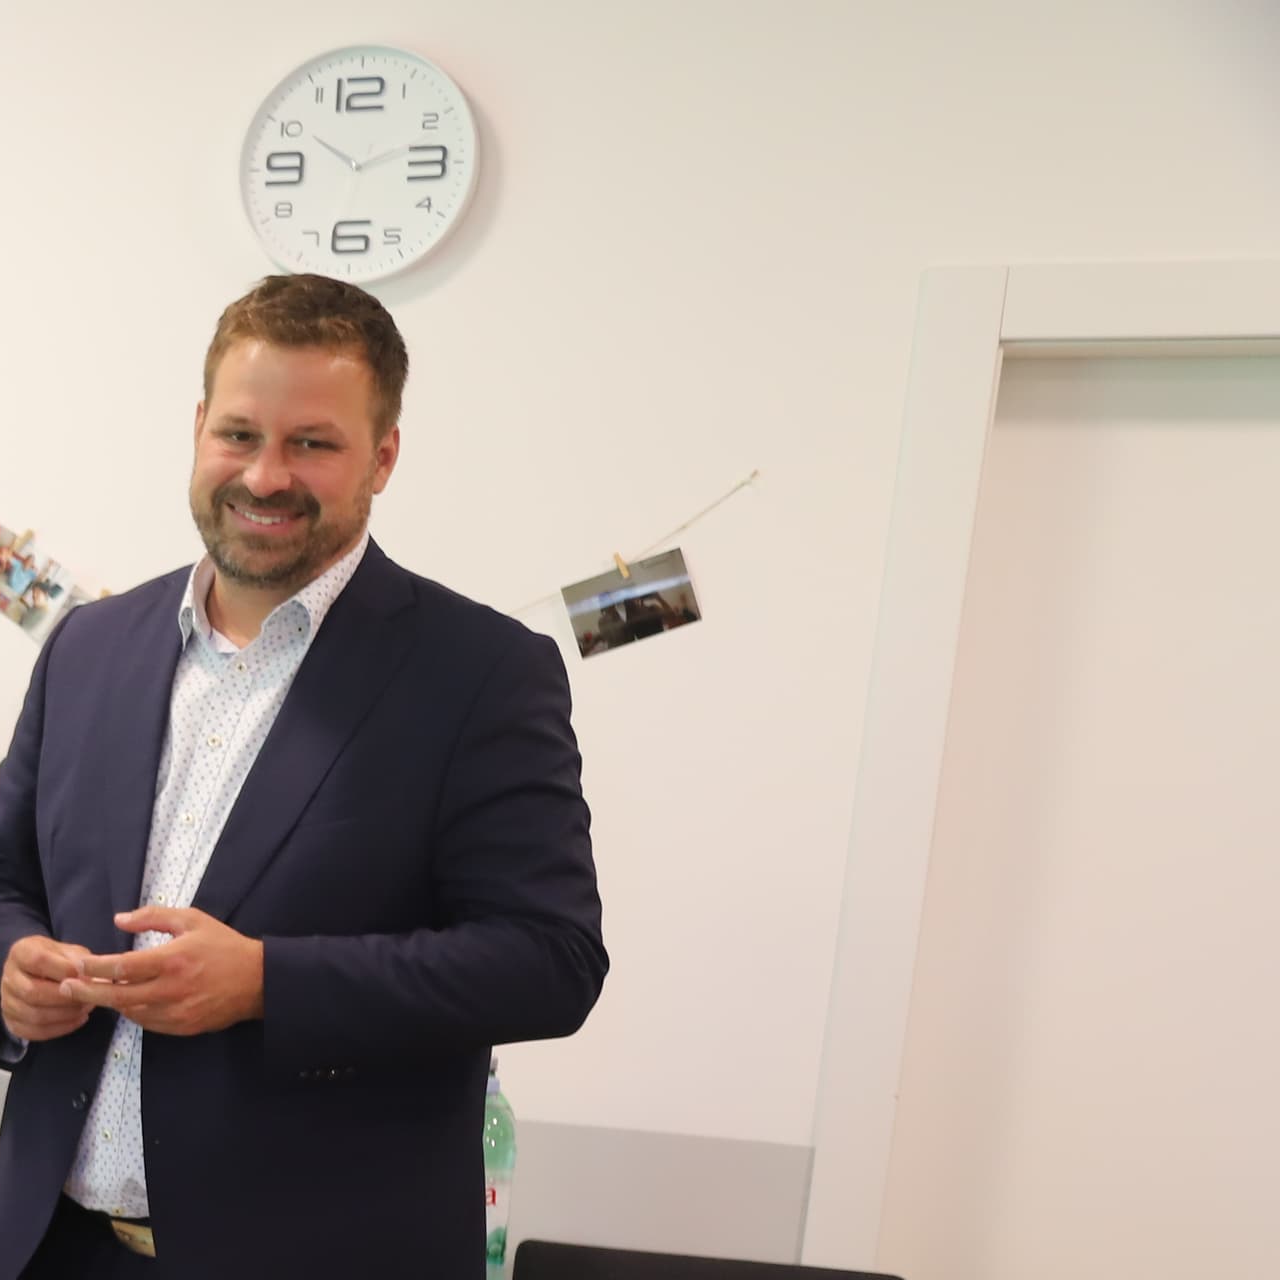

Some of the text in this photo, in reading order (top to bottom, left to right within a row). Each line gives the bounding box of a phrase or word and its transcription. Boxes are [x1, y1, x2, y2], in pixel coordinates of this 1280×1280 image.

[335, 76, 385, 113] 12
[280, 120, 303, 138] 10
[422, 112, 439, 130] 2
[265, 151, 305, 186] 9
[406, 145, 448, 182] 3
[275, 202, 293, 218] 8
[415, 196, 432, 213] 4
[301, 231, 320, 247] 7
[331, 219, 372, 255] 6
[383, 228, 402, 245] 5
